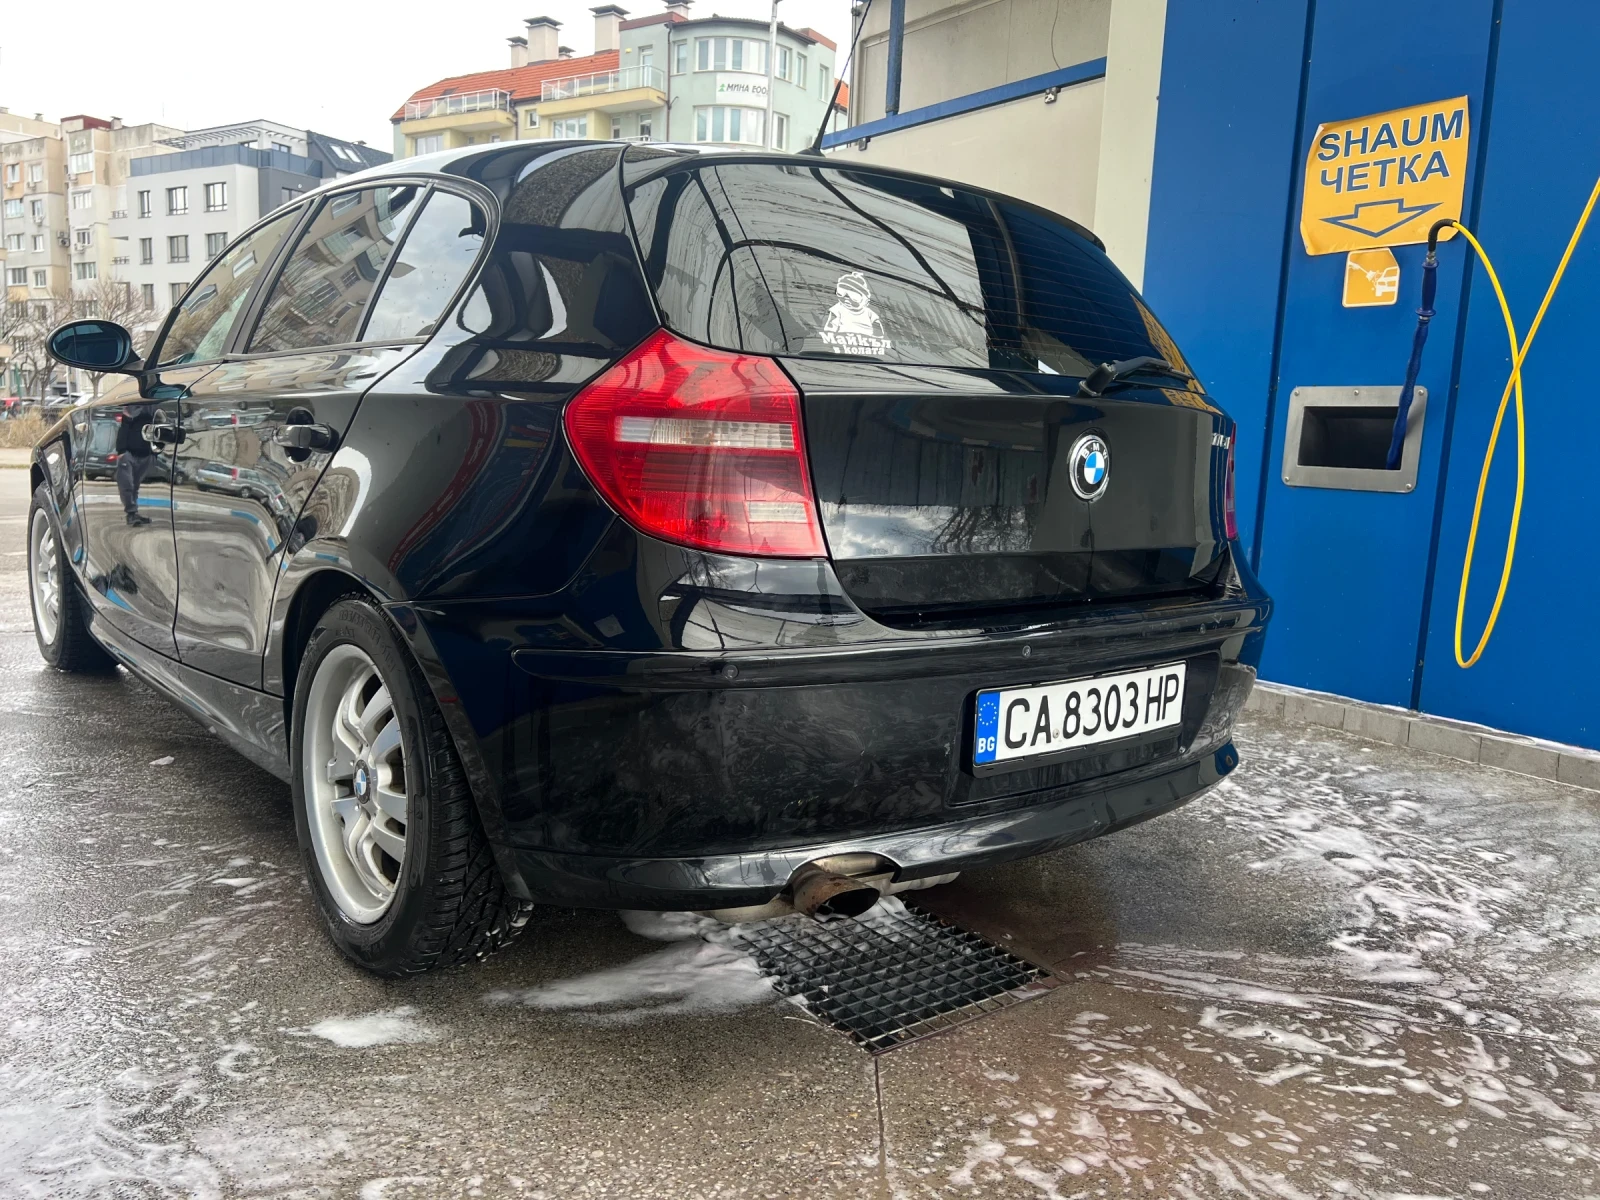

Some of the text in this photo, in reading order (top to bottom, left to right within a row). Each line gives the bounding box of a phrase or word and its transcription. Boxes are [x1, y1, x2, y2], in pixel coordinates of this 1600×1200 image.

[726, 83, 768, 95] МИНА ЕОО
[1317, 108, 1464, 162] SHAUM
[1320, 150, 1450, 194] ЧЕТКА
[819, 331, 891, 349] Майкъл
[843, 345, 885, 355] колата
[1080, 442, 1108, 460] BMW
[977, 737, 995, 754] BG
